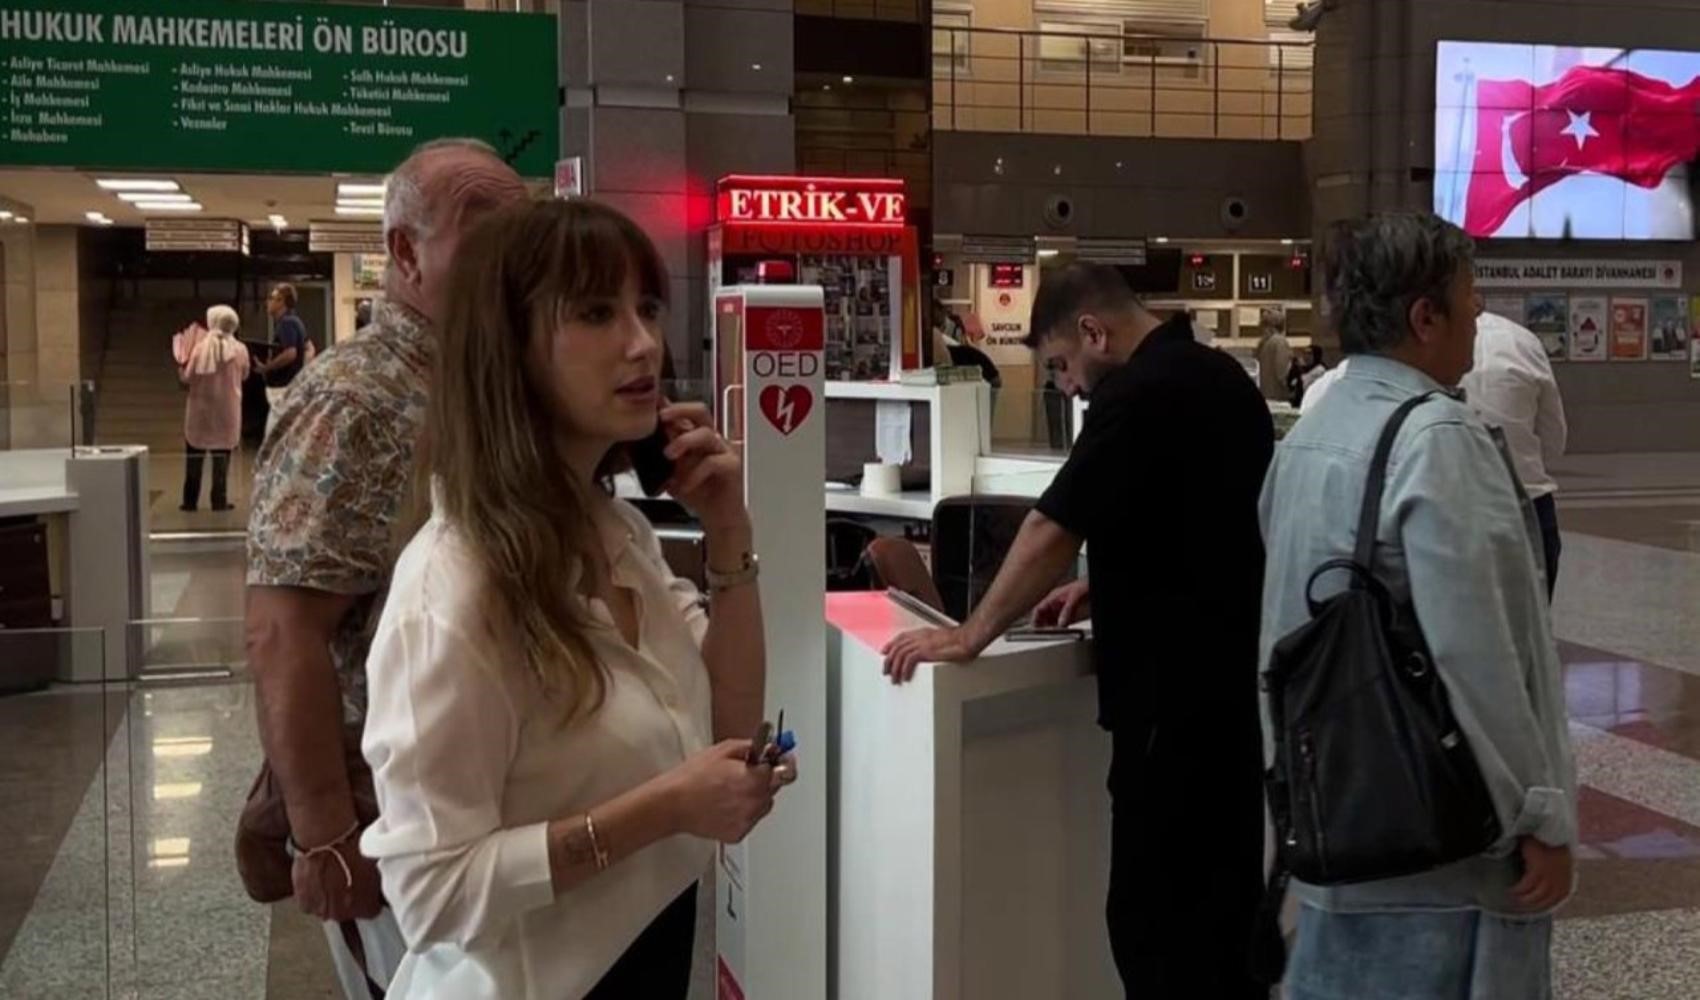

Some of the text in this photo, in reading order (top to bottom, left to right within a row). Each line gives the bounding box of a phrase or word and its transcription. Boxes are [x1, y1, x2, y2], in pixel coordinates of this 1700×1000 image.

[0, 9, 468, 58] HUKUK MAHKEMELERİ ÖN BÜROSU
[10, 56, 150, 74] Asliye Ticaret Mahkemesi
[180, 62, 312, 80] Asliye Hukuk Mahkemesi
[10, 73, 101, 90] Aile Mahkemesi
[375, 70, 408, 84] Hukuk
[410, 71, 469, 87] Mahkemesi
[231, 81, 292, 97] Mahkemesi
[392, 88, 450, 103] Mahkemesi
[23, 92, 90, 107] Mahkemesi
[208, 102, 220, 112] ve
[254, 100, 292, 114] Haklar
[293, 101, 329, 115] Hukuk
[331, 102, 392, 118] Mahkemesi
[38, 111, 103, 126] Mahkemesi
[729, 183, 904, 222] ETRİK-VE
[742, 229, 900, 252] FOTOSHOP
[1253, 277, 1266, 289] 11
[753, 352, 818, 377] OED
